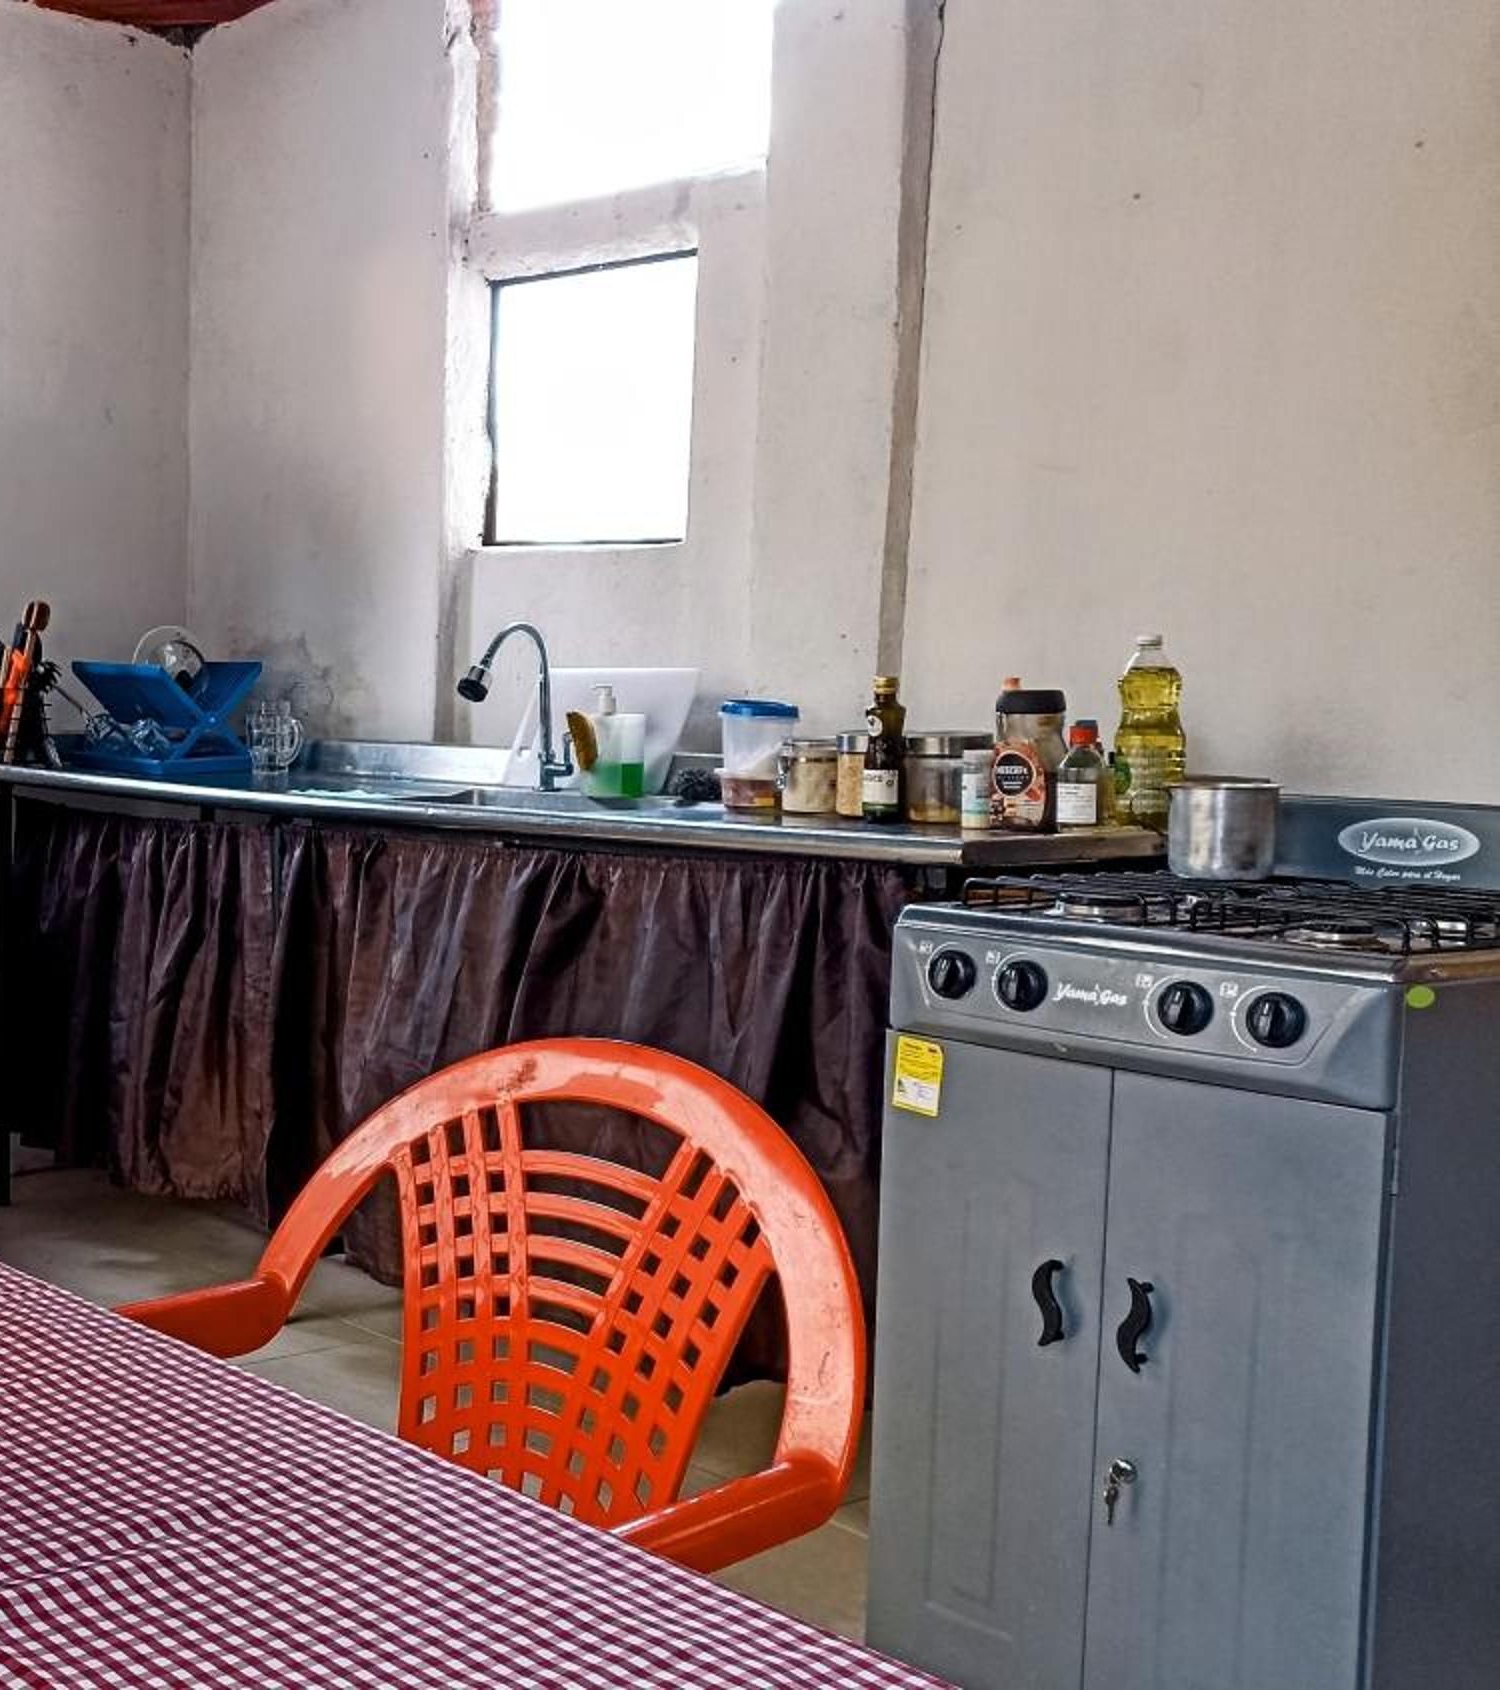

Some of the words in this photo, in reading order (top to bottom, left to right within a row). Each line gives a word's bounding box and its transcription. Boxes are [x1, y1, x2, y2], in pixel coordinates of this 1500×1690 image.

[1357, 831, 1417, 852] Yama
[1421, 835, 1460, 850] Gas
[1052, 982, 1097, 1002] Yama
[1099, 988, 1128, 1007] Gas
